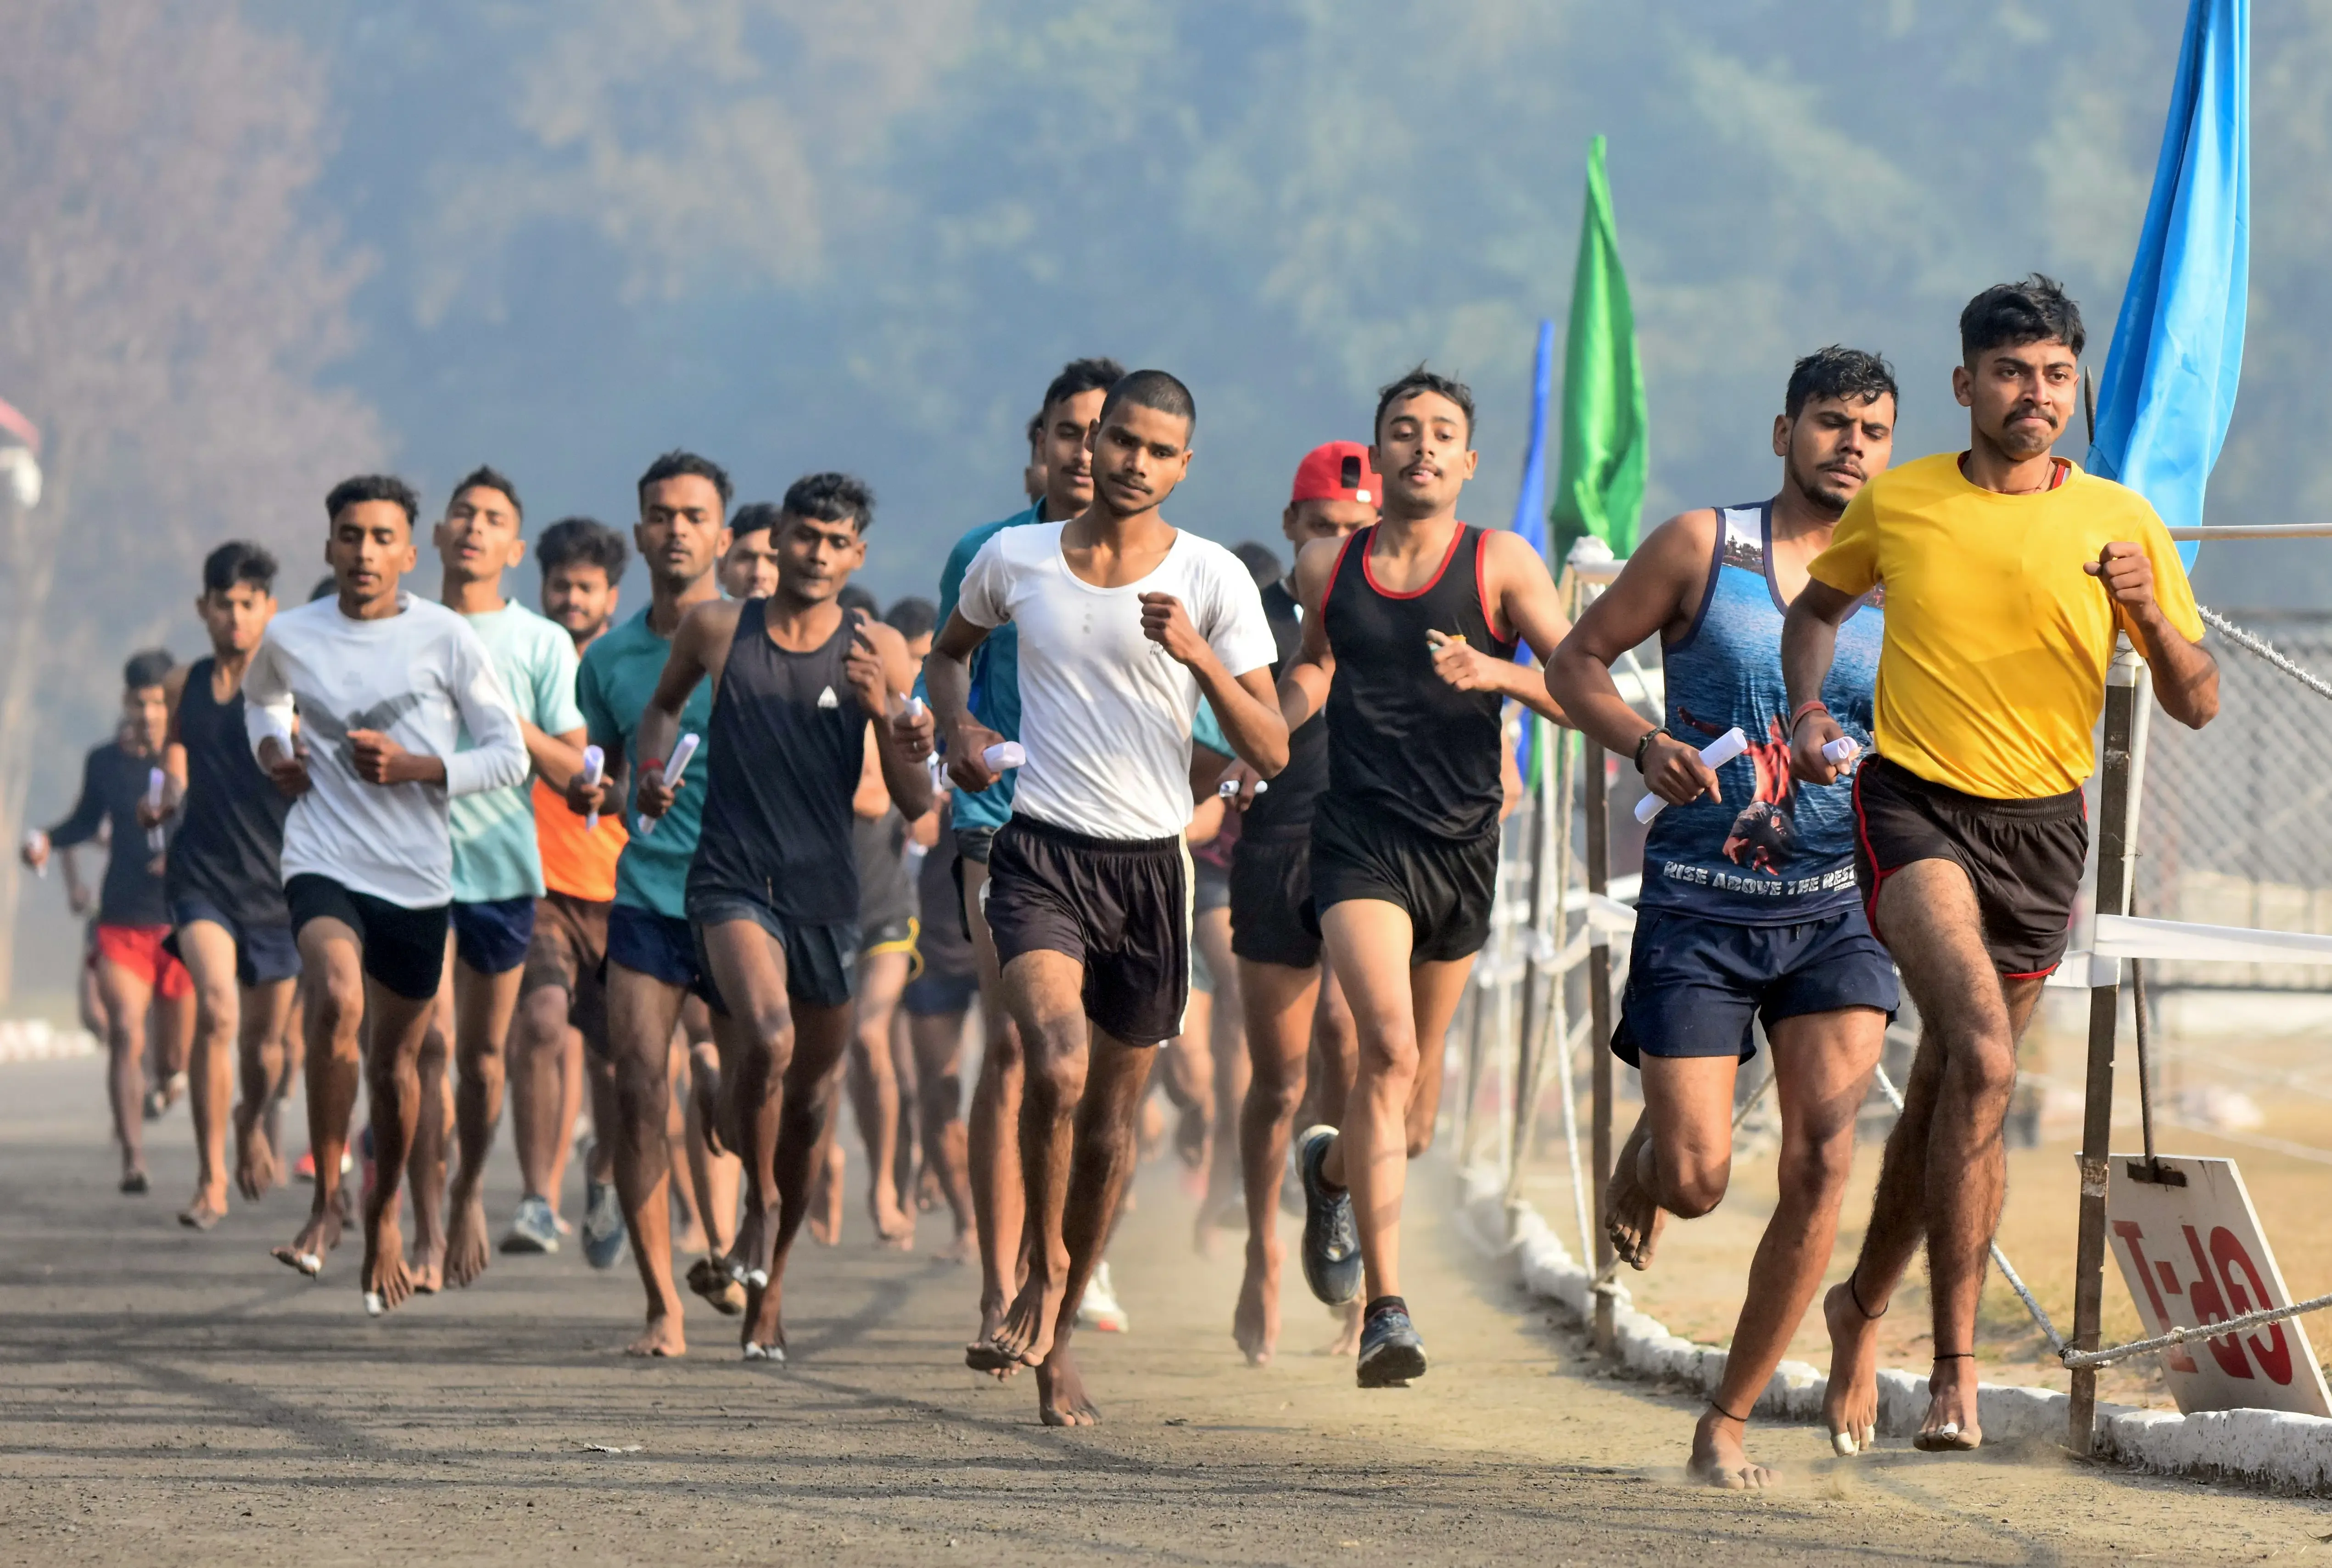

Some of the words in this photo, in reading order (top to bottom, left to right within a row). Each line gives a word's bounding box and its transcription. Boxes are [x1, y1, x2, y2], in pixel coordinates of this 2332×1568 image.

[1664, 861, 1708, 885] RISE
[1712, 873, 1782, 895] ABOVE
[1788, 876, 1819, 895] THE
